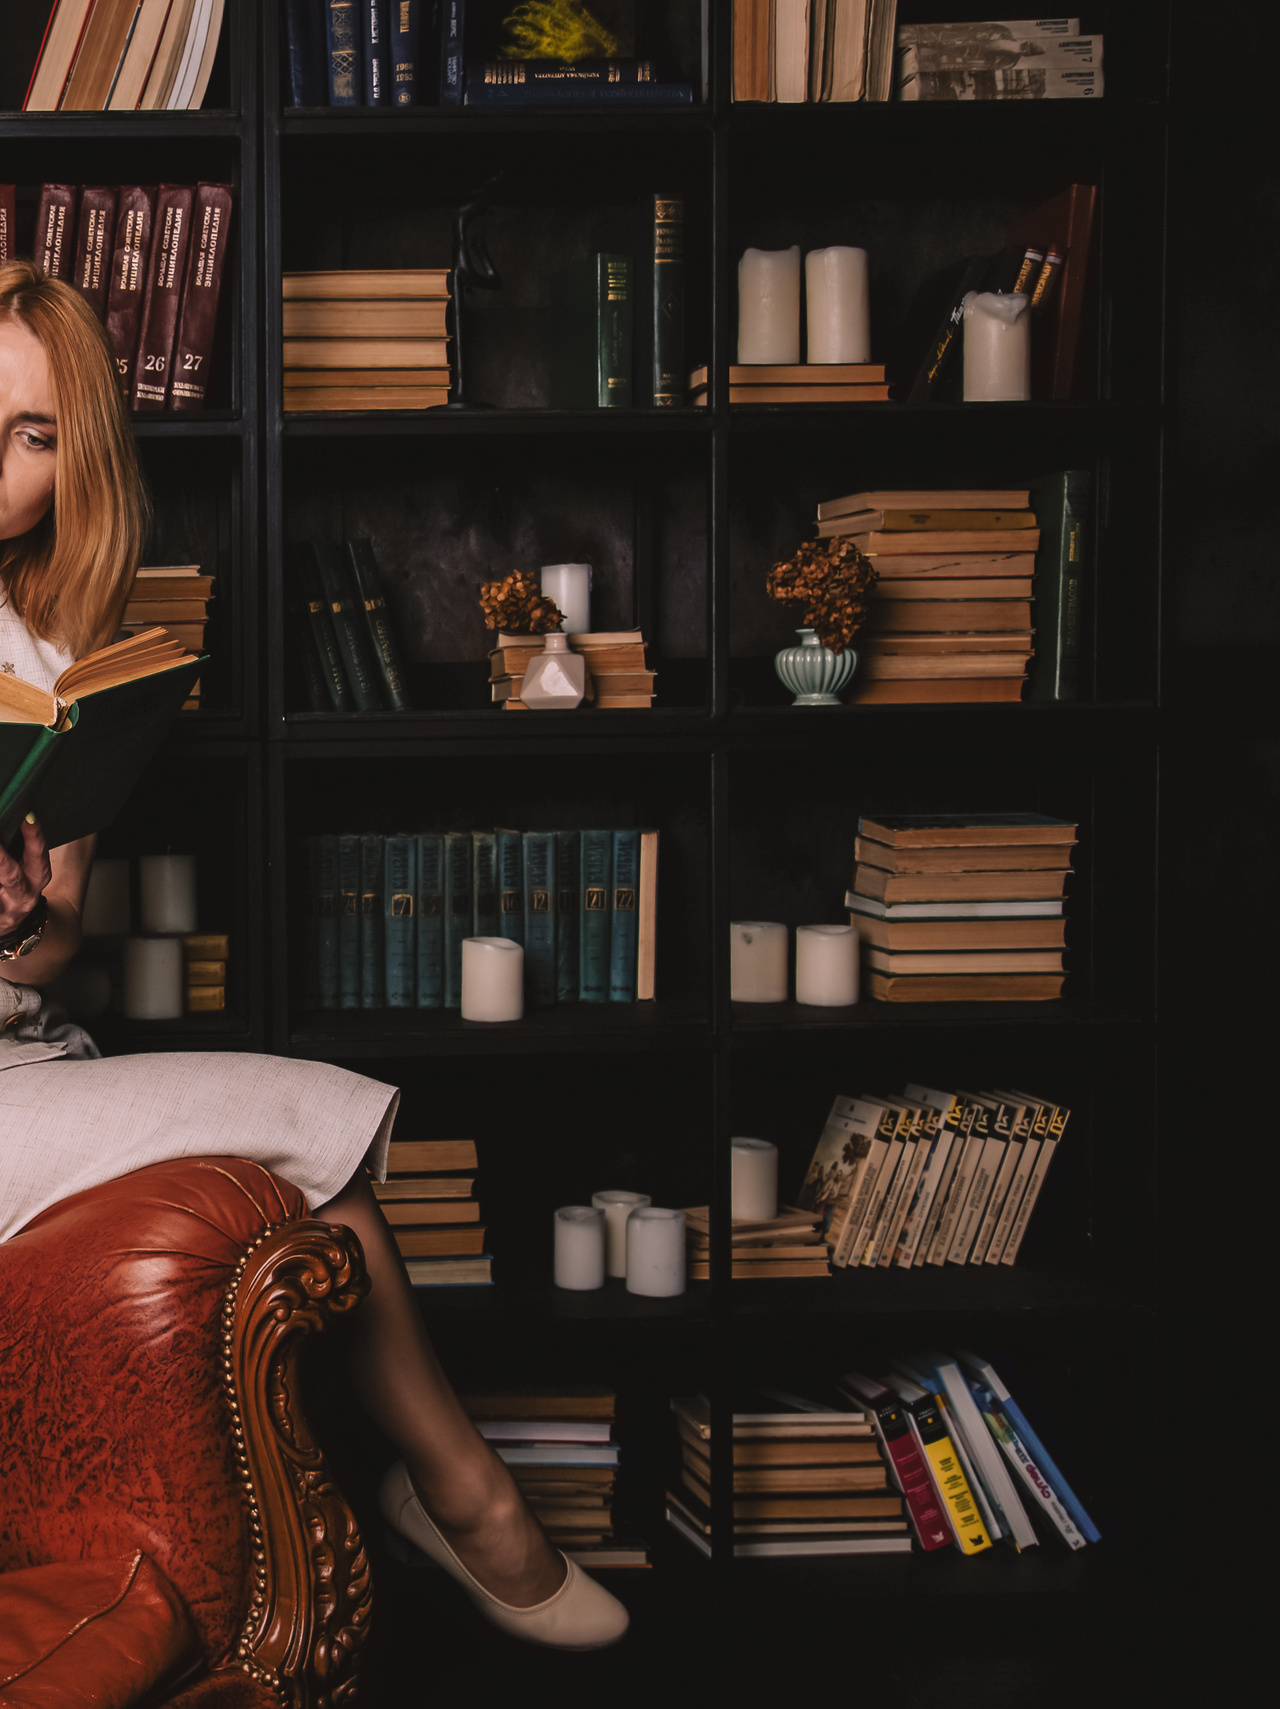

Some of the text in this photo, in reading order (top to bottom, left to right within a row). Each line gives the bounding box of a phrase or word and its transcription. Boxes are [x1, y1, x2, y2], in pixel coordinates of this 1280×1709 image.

[46, 205, 56, 247] СОВЕТСКАЯ
[82, 209, 96, 288] БОЛЬШАЯ СОВЕТСКАЯ
[158, 207, 173, 287] БОЛЬШАЯ СОВЕТСКАЯ
[166, 208, 183, 289] ЭНЦИКЛОПЕДИЯ
[195, 206, 212, 286] БОЛЬШАЯ СОВЕТСКАЯ
[204, 207, 221, 288] ЭНЦИКЛОПЕДИЯ
[92, 210, 106, 290] ЭНЦИКЛОПЕДИЯ
[120, 210, 134, 290] БОЛЬШАЯ СОВЕТСКАЯ
[129, 211, 144, 291] ЭНЦИКЛОПЕДИЯ
[144, 354, 165, 372] 26
[183, 353, 203, 371] 27
[392, 845, 408, 890] БАЛЬЗАК
[503, 843, 518, 887] БАЛЬЗАК
[531, 841, 547, 886] БАЛЬЗАК
[588, 839, 604, 884] БАЛЬЗАК
[617, 839, 633, 884] БАЛЬЗАК
[398, 899, 407, 915] 7
[533, 893, 546, 910] 12
[590, 892, 602, 908] 21
[618, 892, 632, 908] 22
[1023, 1461, 1053, 1500] супер
